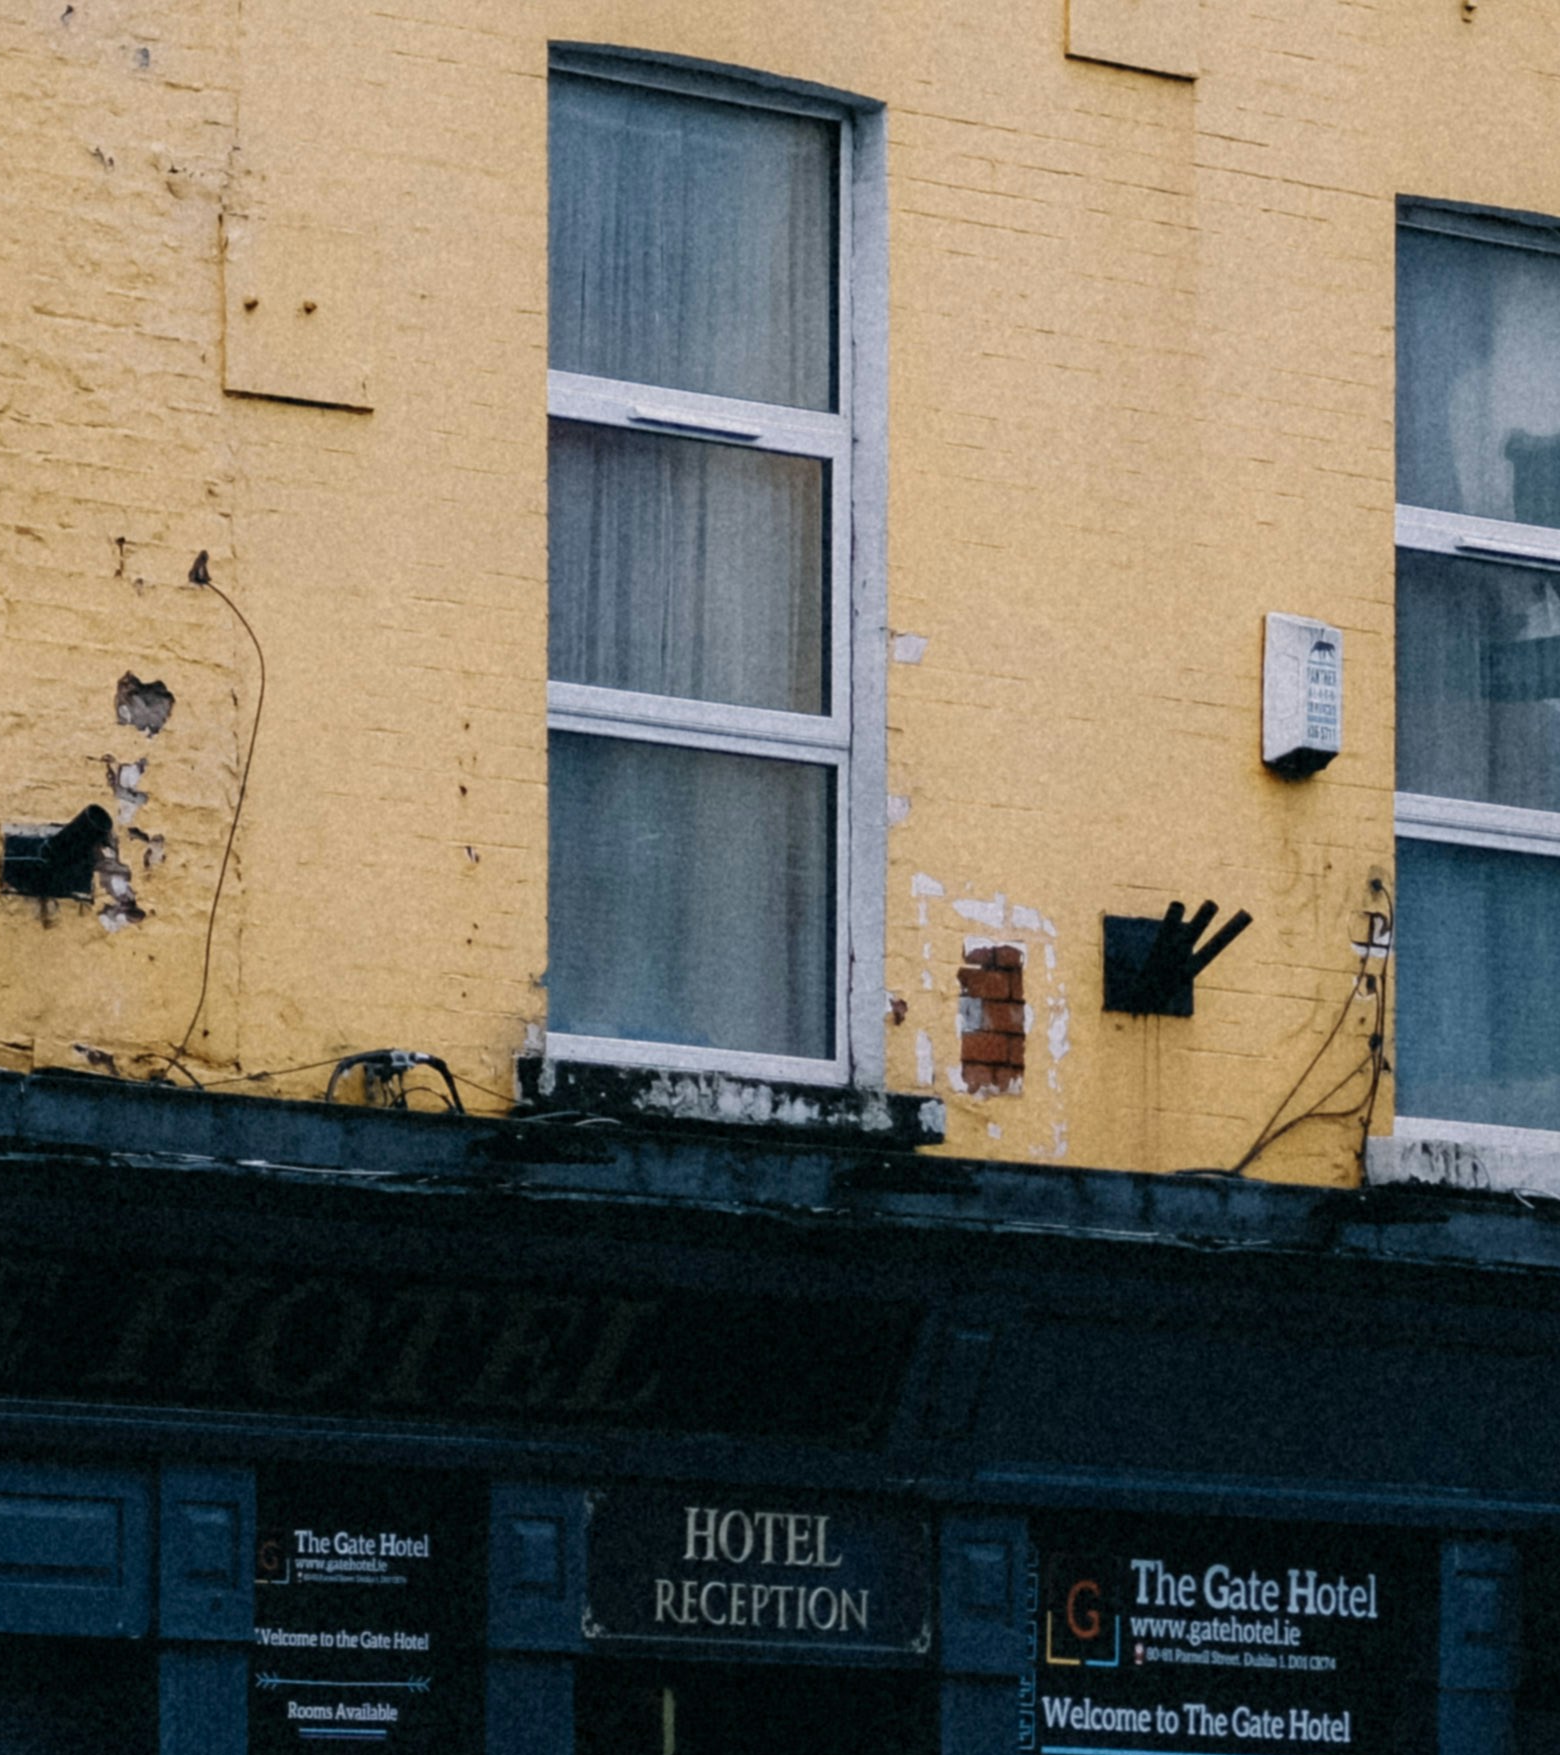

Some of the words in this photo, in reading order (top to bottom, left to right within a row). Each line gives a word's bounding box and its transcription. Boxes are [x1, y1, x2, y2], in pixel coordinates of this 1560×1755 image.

[80, 1270, 662, 1411] HOTEL
[294, 1529, 331, 1554] The
[333, 1531, 377, 1556] Gate
[379, 1533, 429, 1558] Hotel
[683, 1506, 843, 1568] HOTEL
[654, 1578, 870, 1632] RECEPTION
[1066, 1579, 1101, 1639] G
[1130, 1558, 1198, 1608] The
[1203, 1563, 1280, 1614] Gate
[1286, 1568, 1378, 1619] Hotel
[320, 1631, 334, 1648] to
[336, 1629, 359, 1649] the
[359, 1631, 392, 1650] Gate
[392, 1632, 429, 1651] Hotel
[1129, 1615, 1302, 1648] www.gatehotel.ie
[287, 1700, 333, 1720] Rooms
[335, 1702, 398, 1722] Available
[1040, 1696, 1151, 1734] Welcome
[1155, 1704, 1180, 1735] to
[1183, 1703, 1229, 1737] The
[1232, 1706, 1286, 1740] Gate
[1288, 1708, 1352, 1743] Hotel
